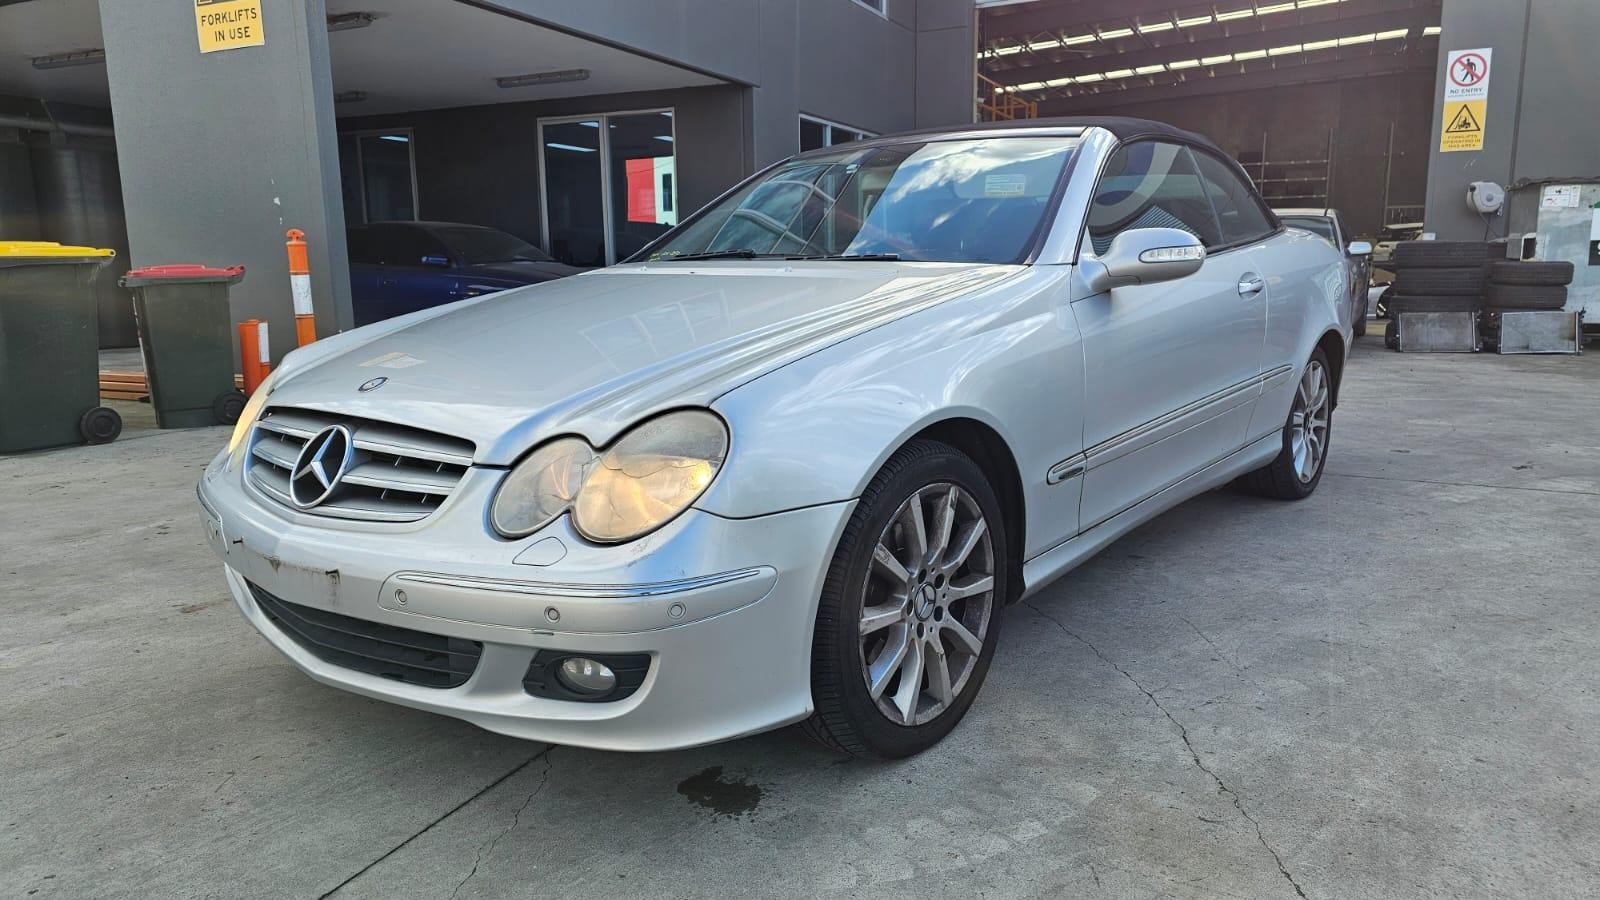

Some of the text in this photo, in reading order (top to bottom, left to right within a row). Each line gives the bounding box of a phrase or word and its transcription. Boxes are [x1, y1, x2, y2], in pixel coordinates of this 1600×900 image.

[201, 7, 257, 26] FORKLIFTS
[214, 26, 251, 42] IN USE
[1461, 87, 1484, 95] ENTRY
